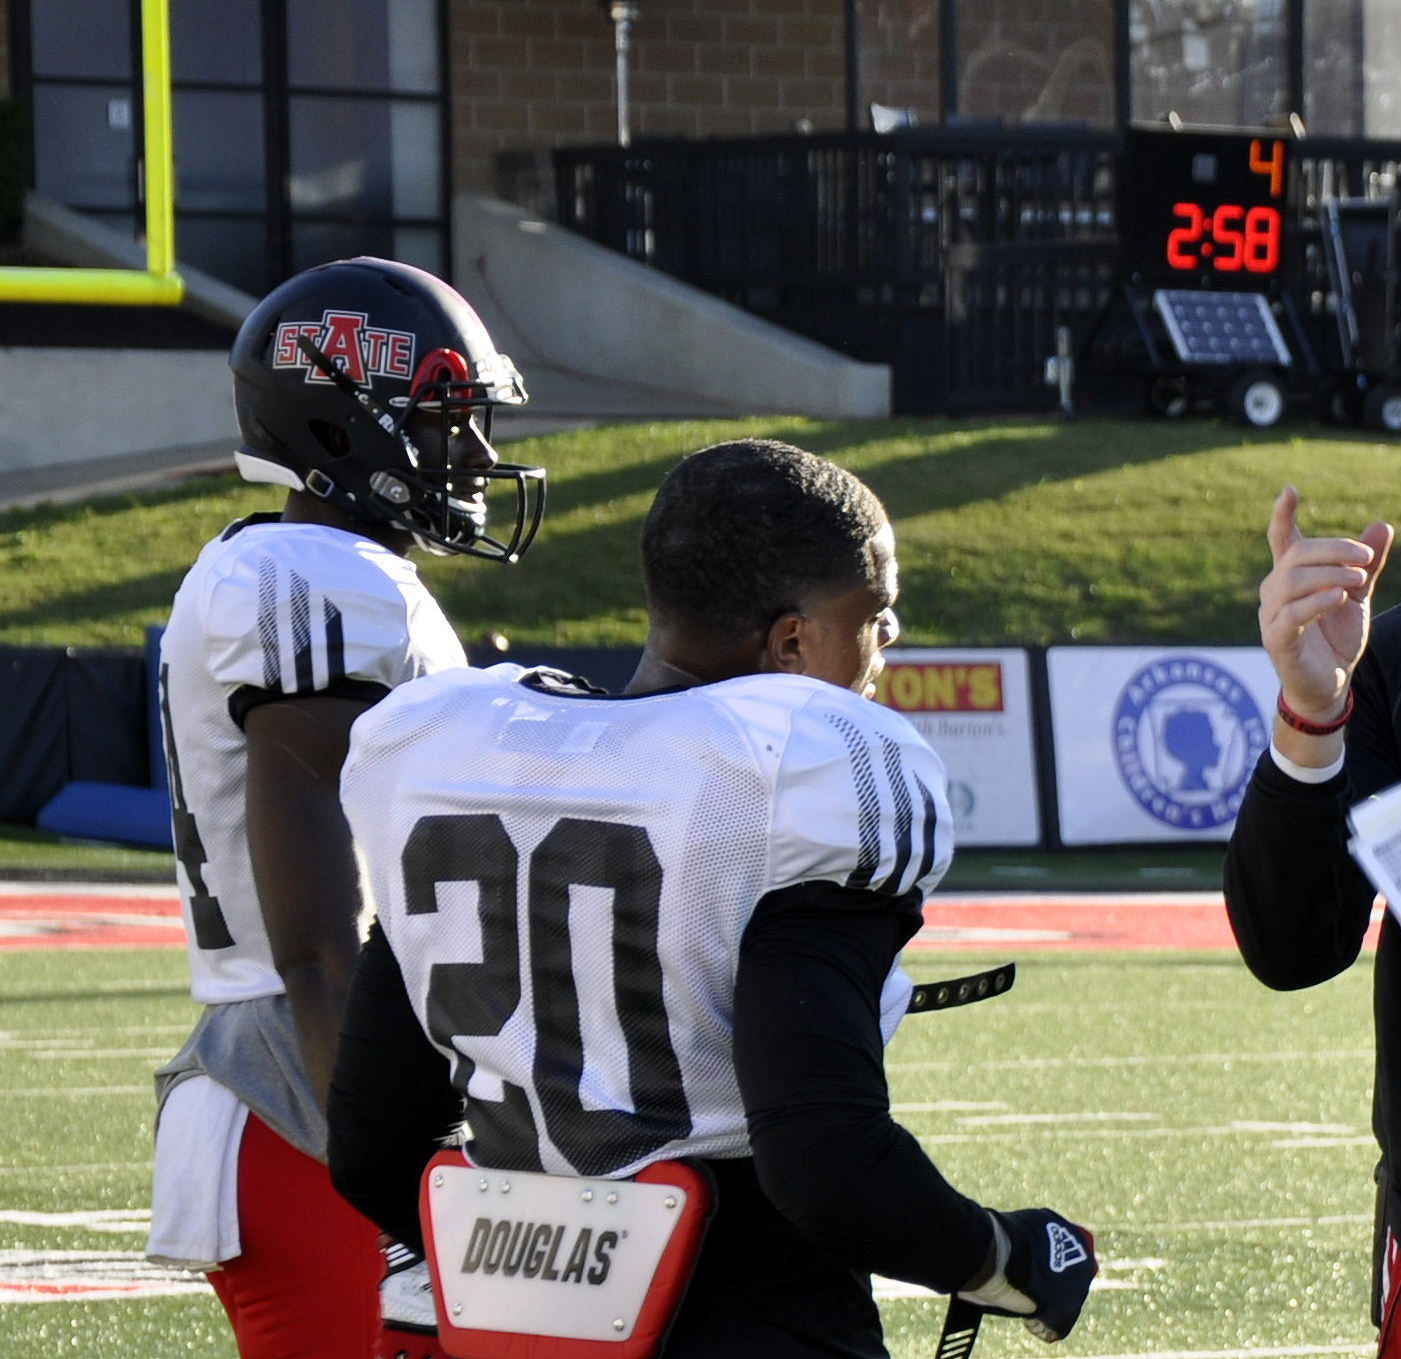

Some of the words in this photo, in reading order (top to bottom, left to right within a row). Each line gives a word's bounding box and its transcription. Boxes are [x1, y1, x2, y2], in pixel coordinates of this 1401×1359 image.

[1250, 139, 1284, 198] 4
[1167, 203, 1280, 273] 2:58
[274, 311, 414, 387] STATE
[1126, 660, 1243, 707] Arkansas
[401, 813, 695, 1178] 20
[461, 1217, 619, 1286] DOUGLAS
